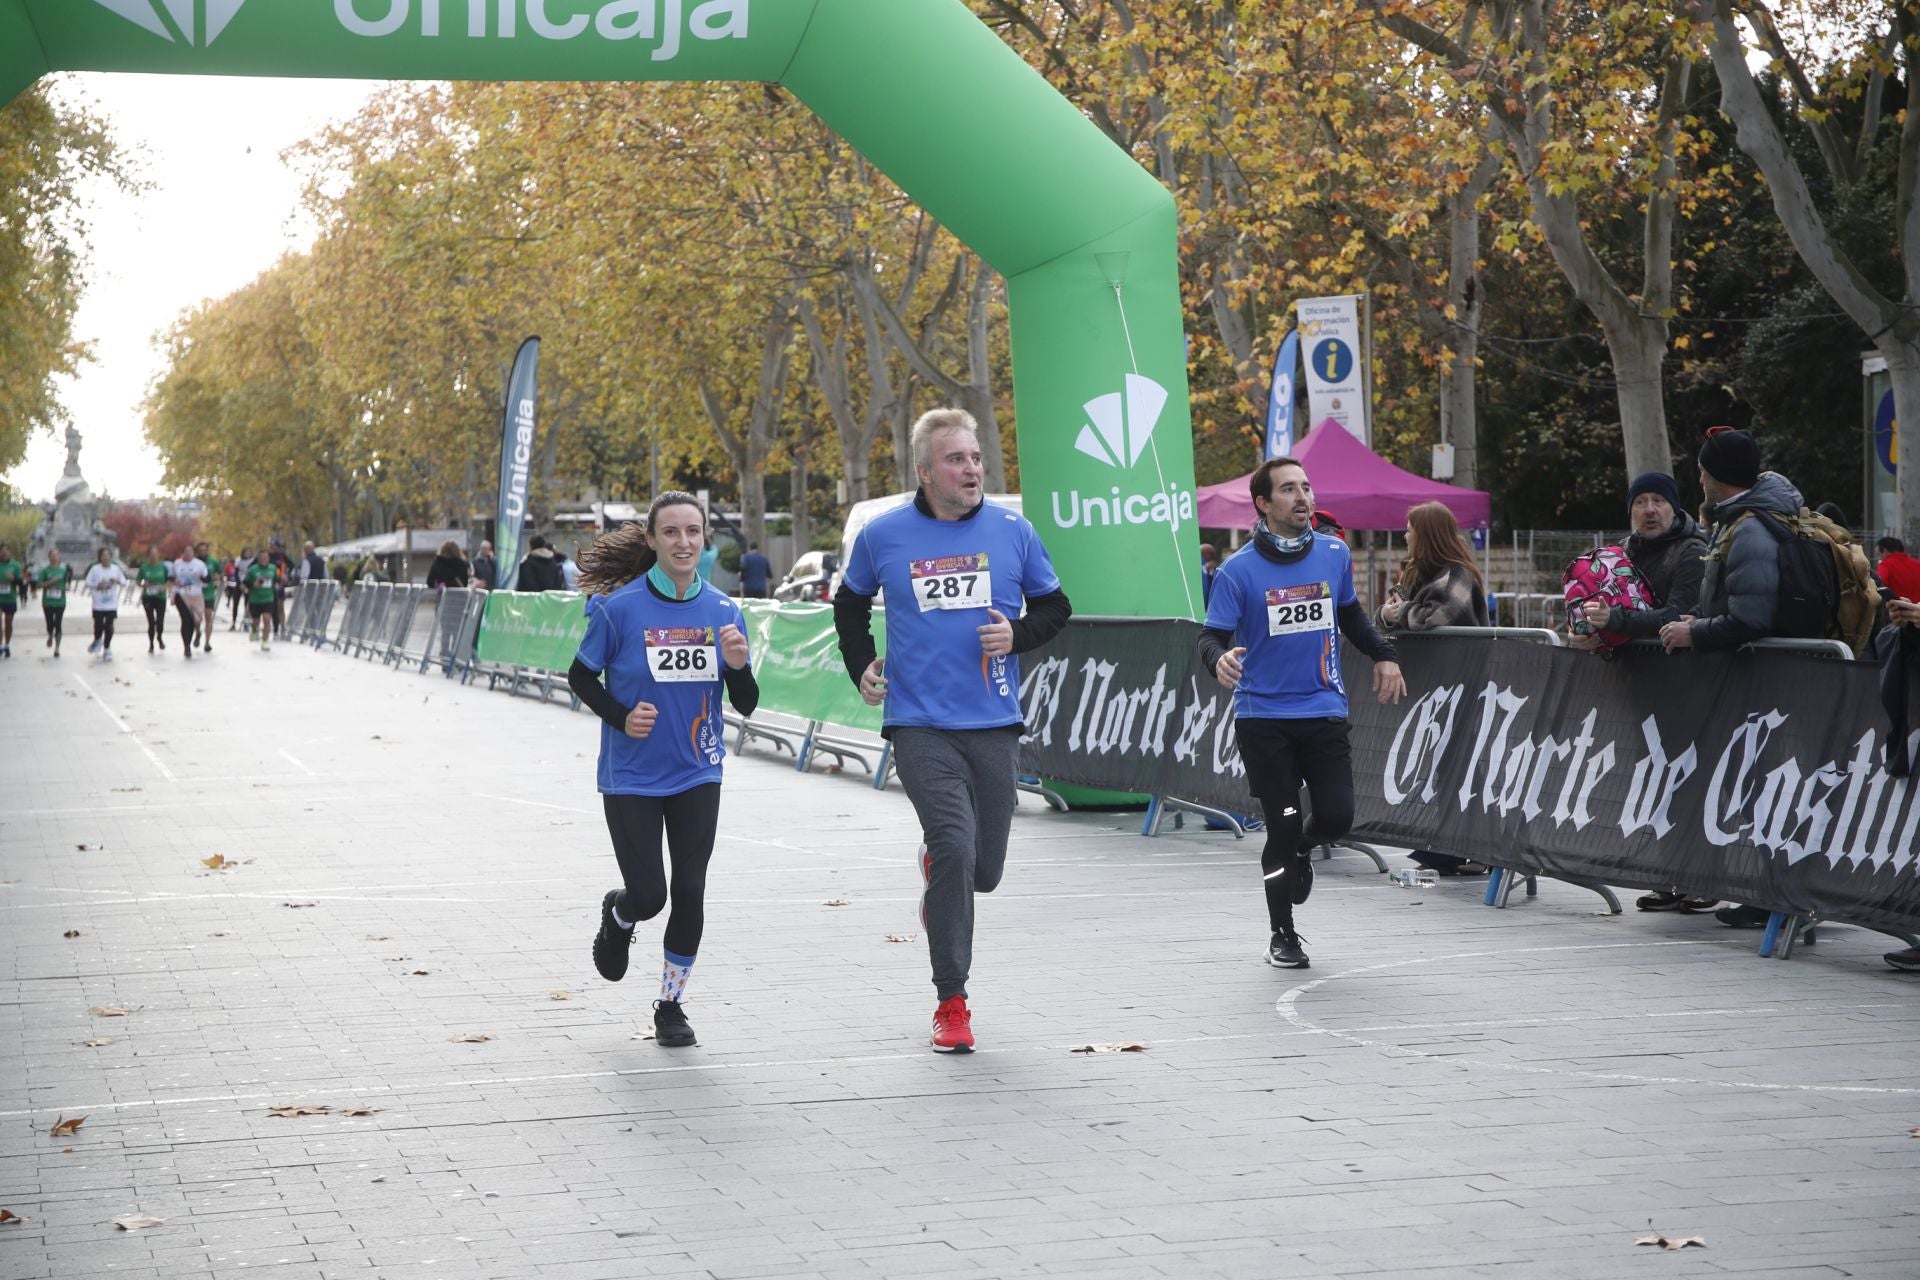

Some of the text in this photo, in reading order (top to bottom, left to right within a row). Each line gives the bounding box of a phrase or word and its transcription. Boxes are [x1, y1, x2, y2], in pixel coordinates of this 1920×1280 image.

[334, 0, 749, 61] Unicaja
[506, 398, 534, 518] Unicaja
[1052, 482, 1193, 533] Unicaja
[924, 575, 978, 599] 287
[1278, 602, 1323, 626] 288
[658, 648, 707, 671] 286
[1068, 656, 1176, 758] Norte
[1174, 674, 1217, 767] de
[700, 726, 709, 749] grupo
[1383, 683, 1464, 805] El
[1458, 680, 1616, 832] Norte
[1617, 713, 1698, 840] de
